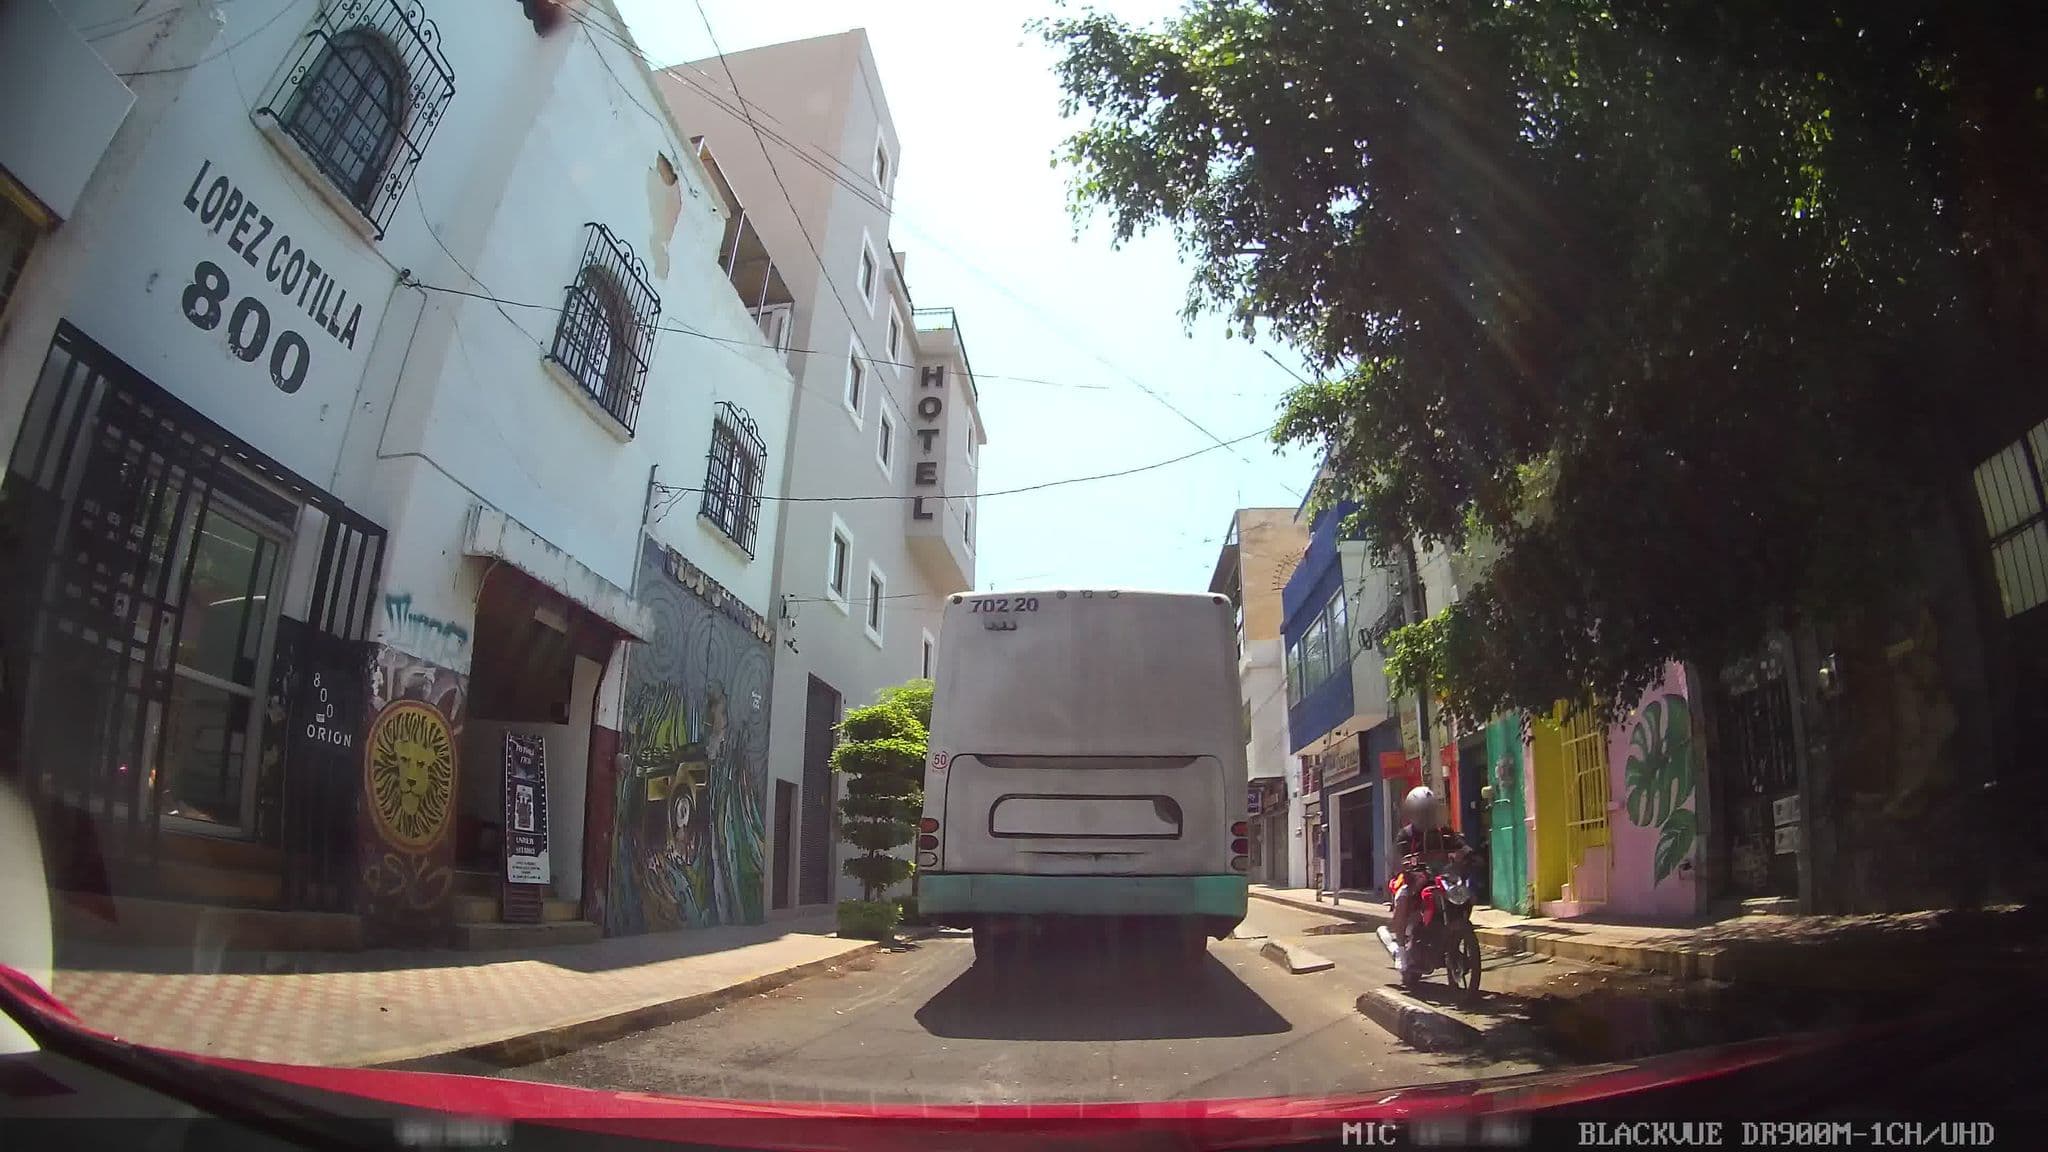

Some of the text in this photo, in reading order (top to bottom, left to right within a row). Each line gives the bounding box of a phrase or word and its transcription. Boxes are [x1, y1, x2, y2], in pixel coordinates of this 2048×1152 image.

[183, 159, 363, 351] LOPEZ COTILLA
[182, 261, 310, 394] 800
[913, 365, 945, 521] HOTEL
[970, 597, 1039, 613] 702 20
[313, 672, 335, 719] 800
[306, 724, 352, 748] ORION
[934, 754, 947, 766] 50
